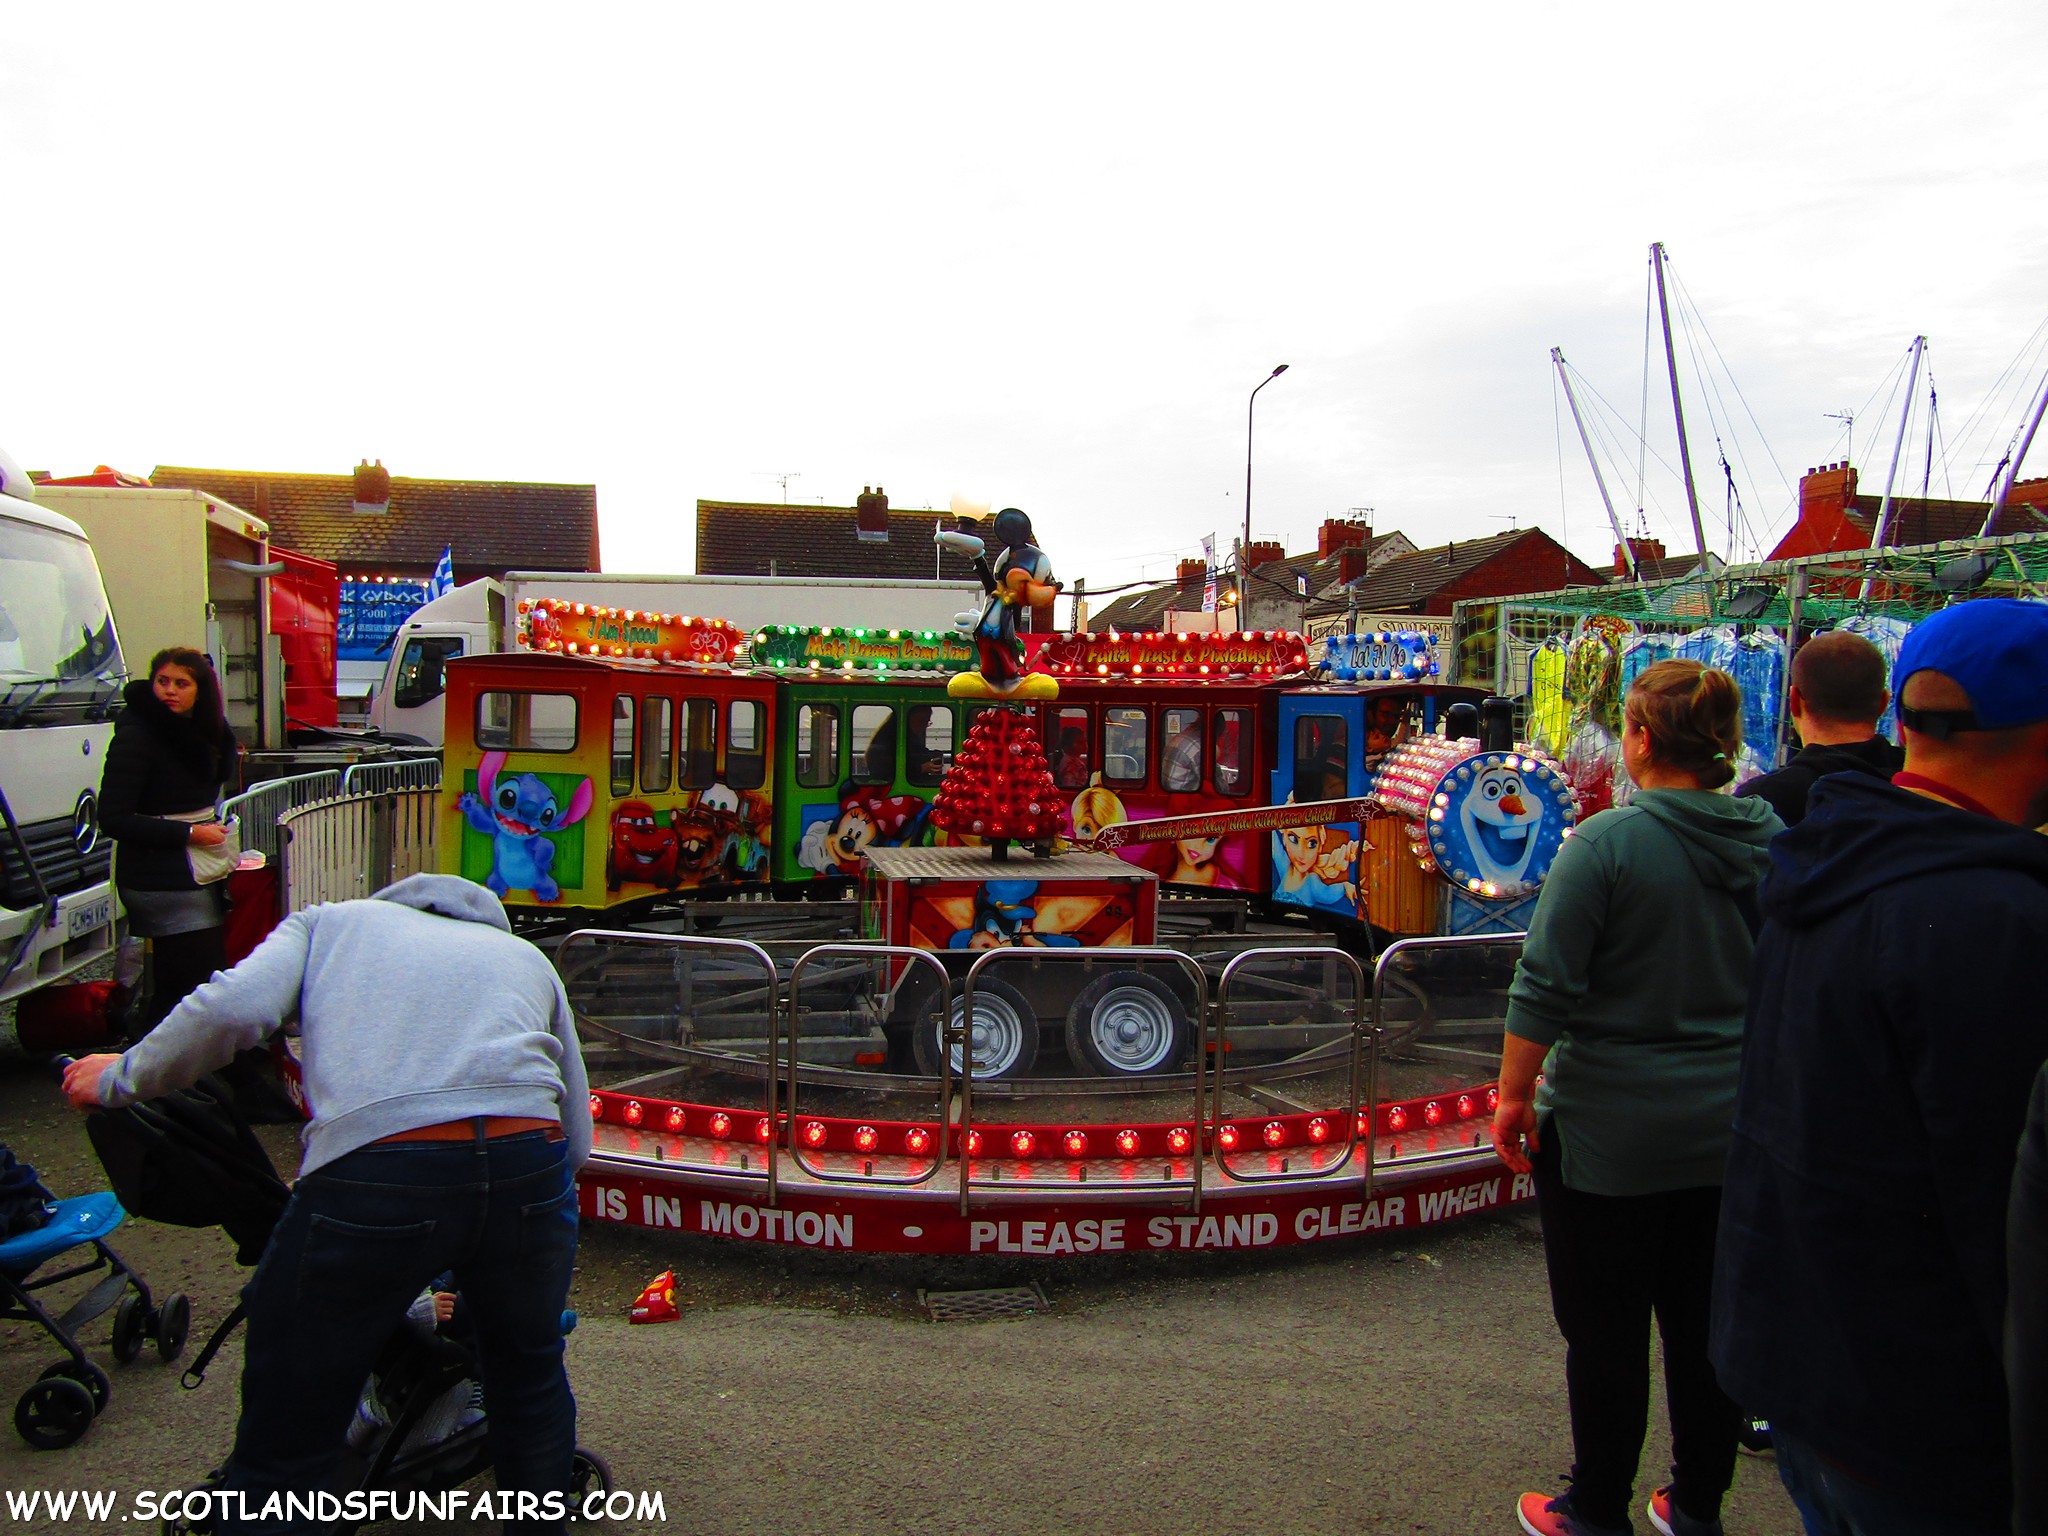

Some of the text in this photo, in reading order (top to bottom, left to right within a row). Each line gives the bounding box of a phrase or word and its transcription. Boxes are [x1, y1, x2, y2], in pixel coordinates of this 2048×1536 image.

[597, 620, 619, 641] Am
[621, 620, 660, 646] Speed
[806, 635, 972, 661] Make Dreams Come True
[1086, 644, 1131, 663] Faith
[1138, 644, 1179, 666] Trust
[1182, 645, 1194, 663] &
[1351, 643, 1407, 671] Let It Go
[1138, 824, 1178, 841] Parents
[596, 1186, 627, 1221] IS
[643, 1194, 682, 1228] IN
[701, 1200, 854, 1247] MOTION
[970, 1219, 1126, 1254] PLEASE
[1147, 1213, 1279, 1248] STAND
[1294, 1197, 1405, 1240] CLEAR
[1418, 1178, 1501, 1223] WHEN
[1511, 1173, 1536, 1201] RI
